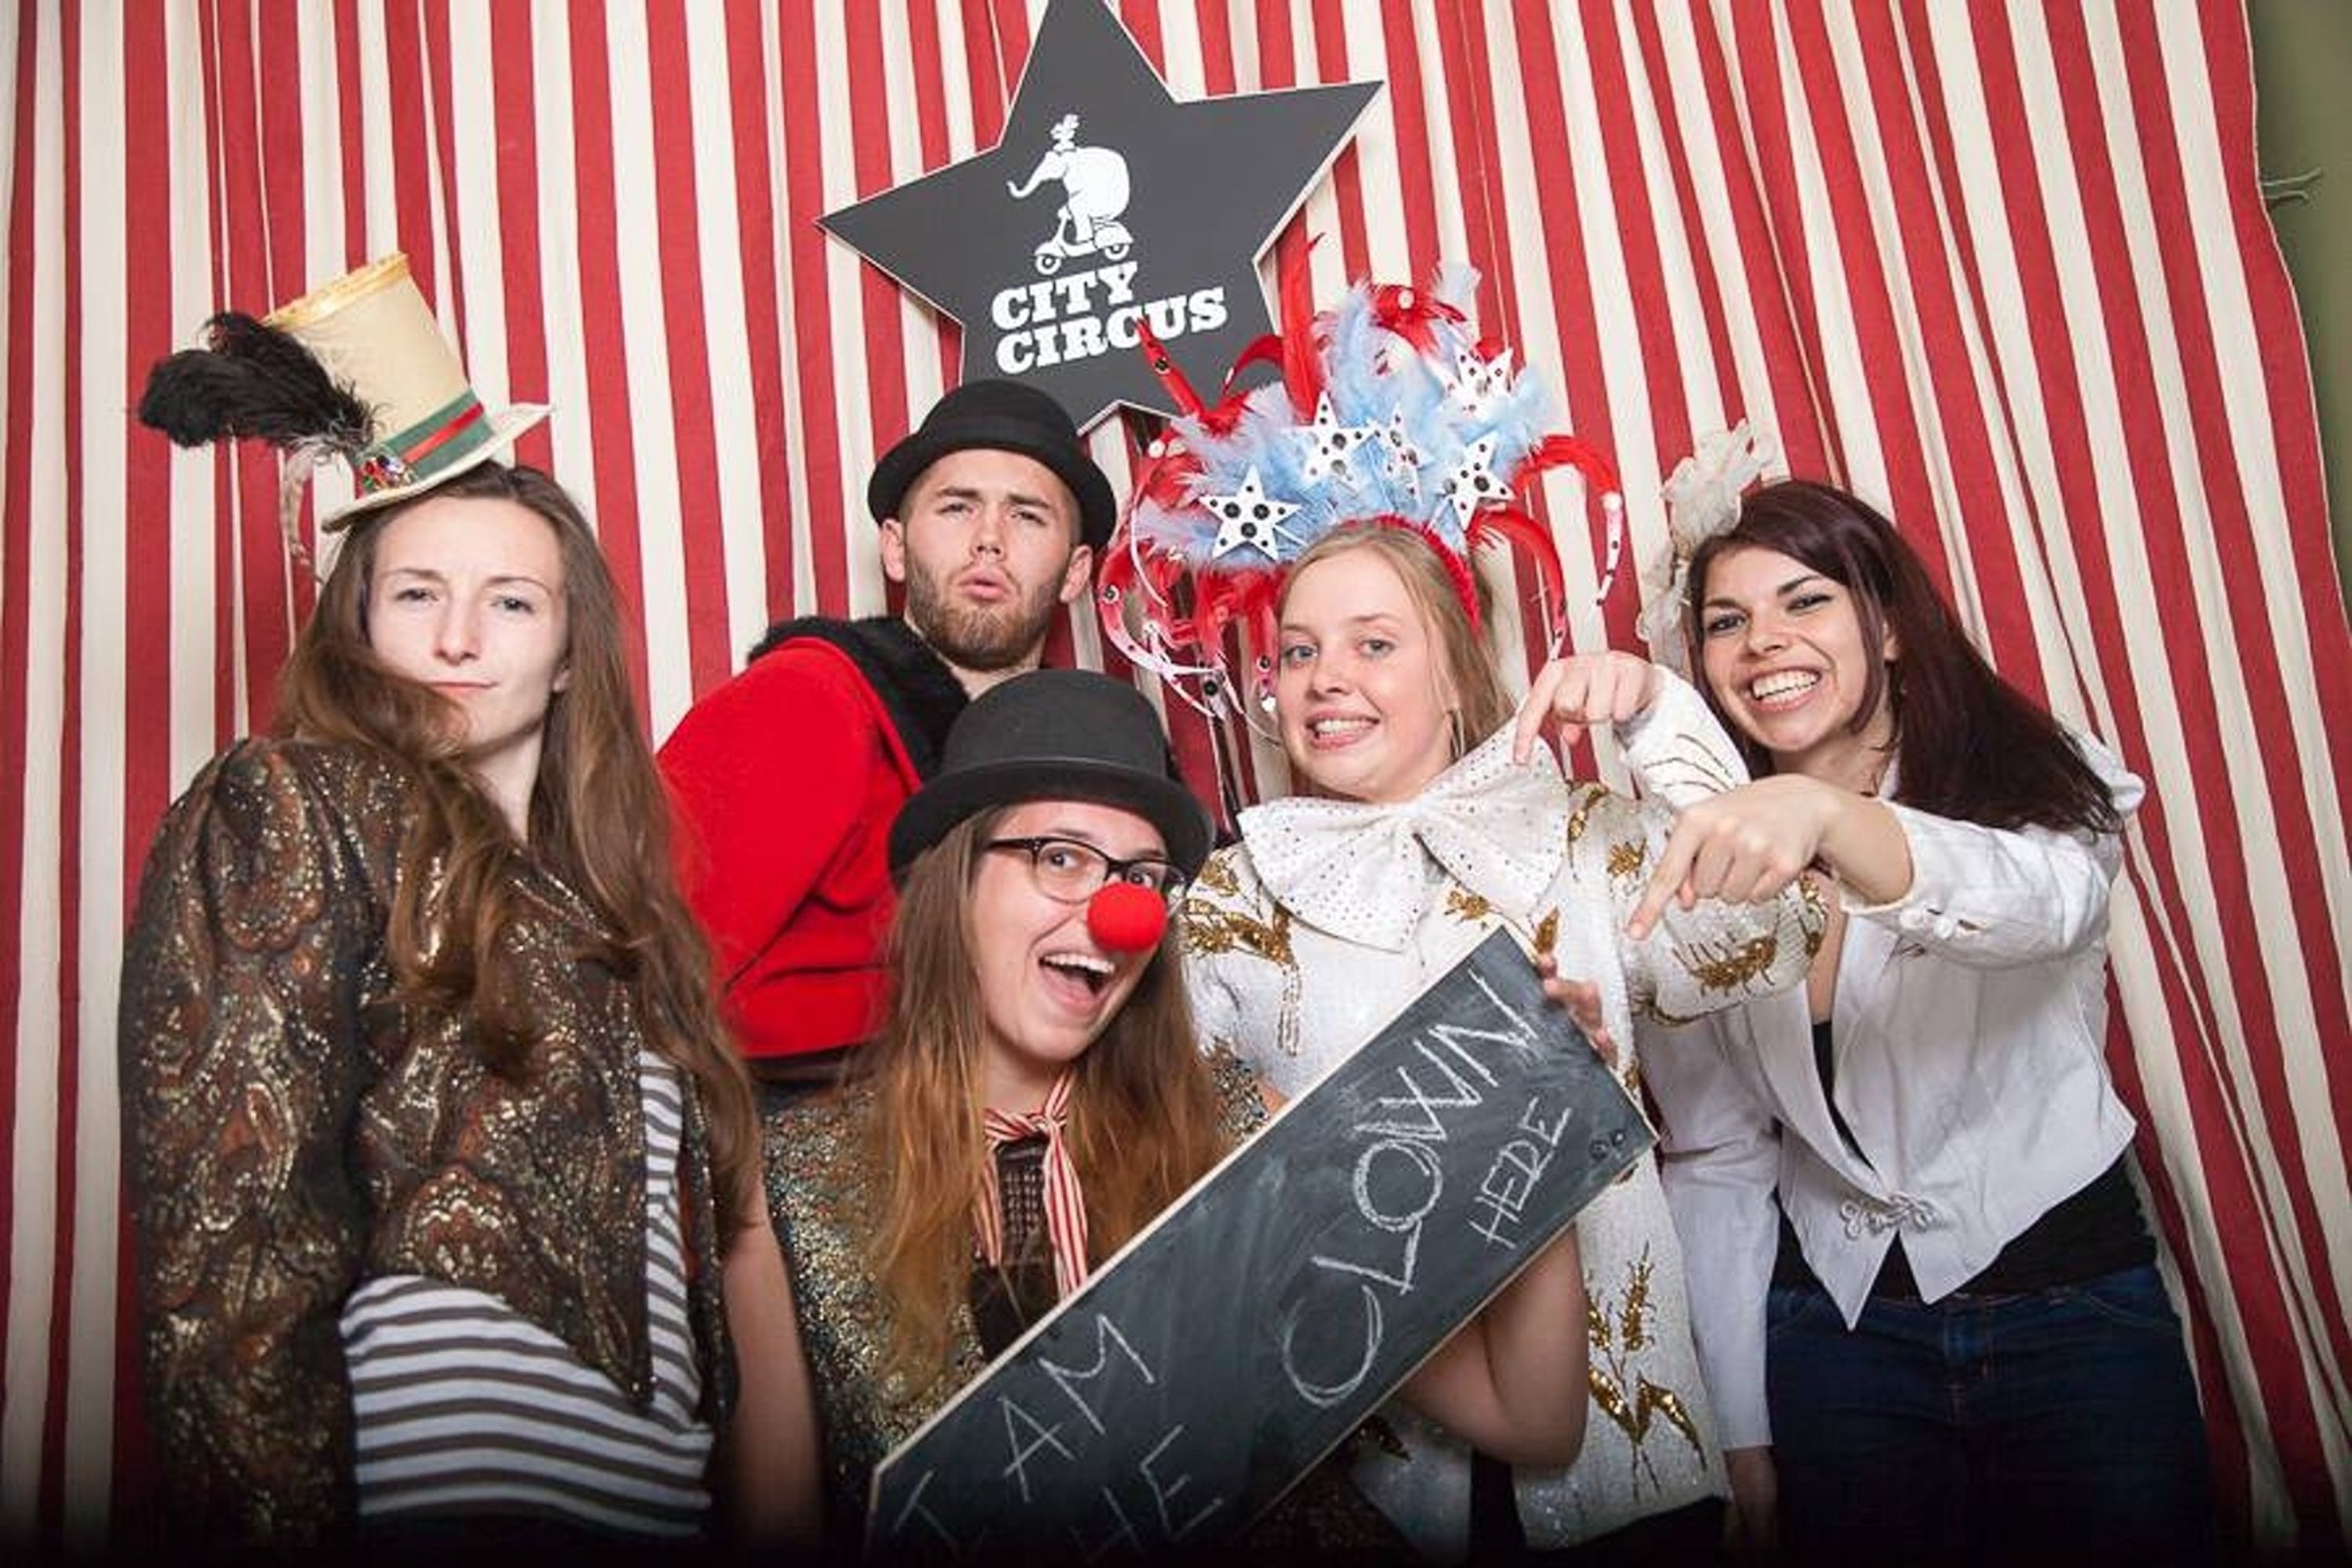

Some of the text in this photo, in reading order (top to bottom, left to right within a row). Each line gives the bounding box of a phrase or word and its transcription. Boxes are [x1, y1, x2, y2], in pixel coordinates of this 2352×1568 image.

[992, 261, 1138, 330] CITY
[995, 287, 1229, 375] CIRCUS
[1067, 968, 1541, 1560] HE CLOWN
[998, 1313, 1156, 1503] AM
